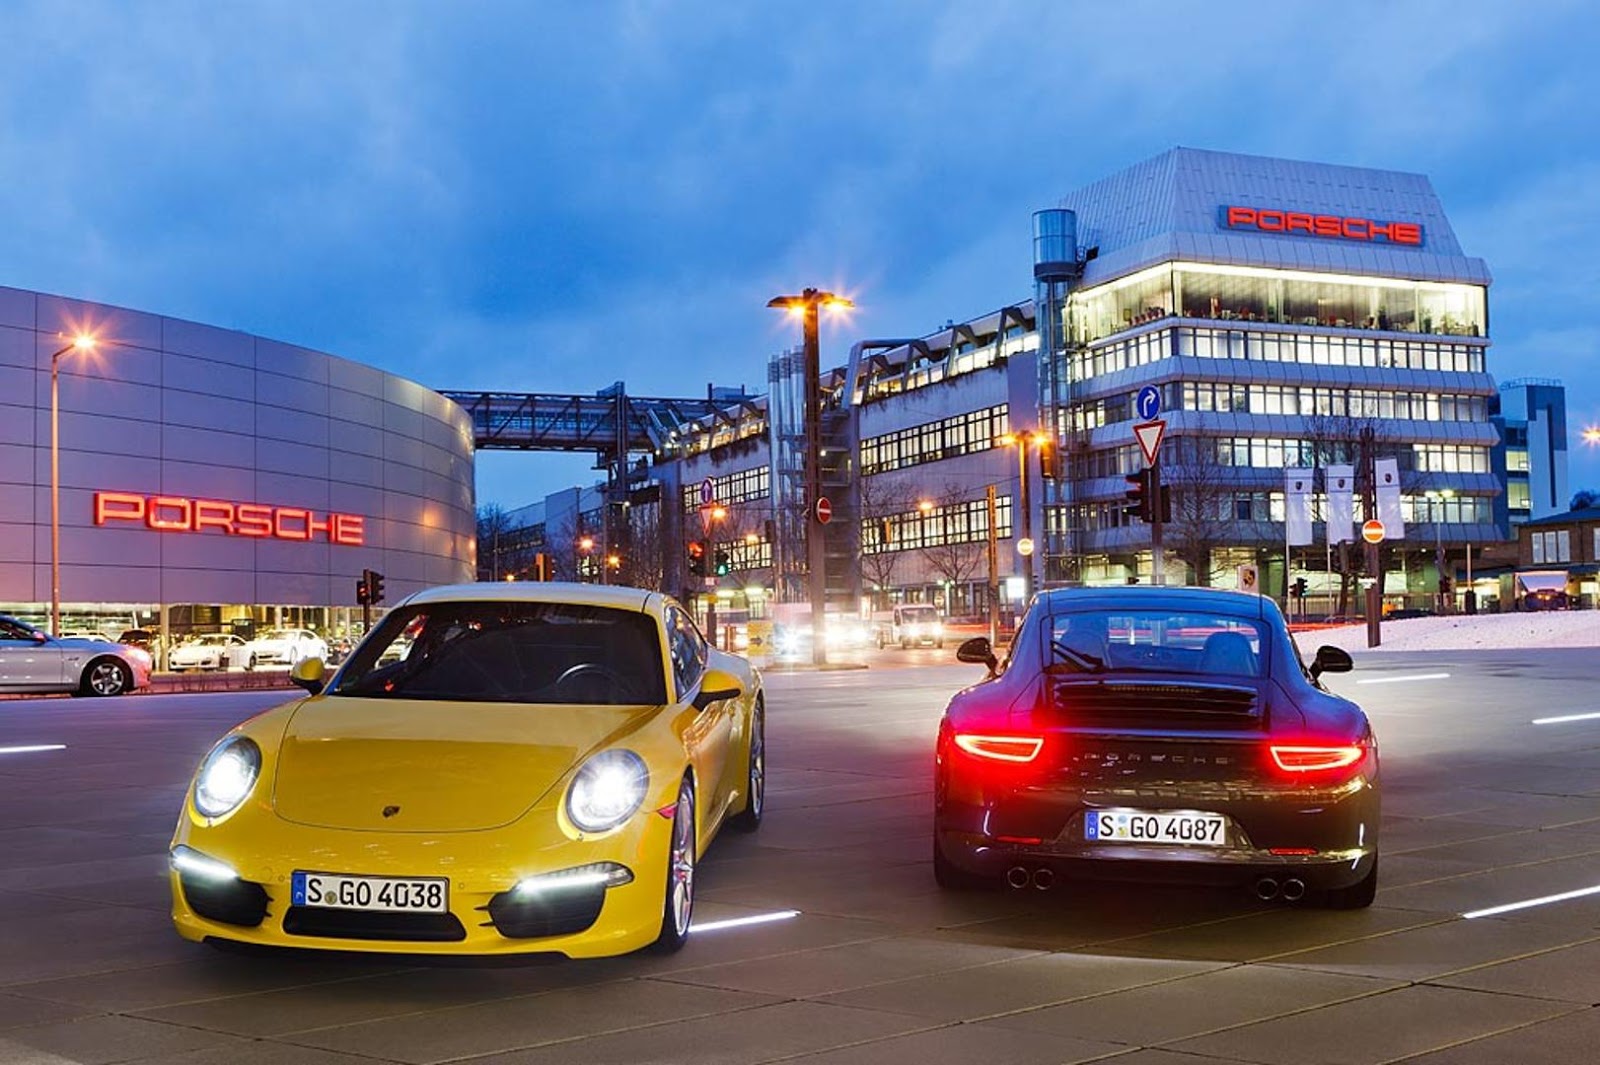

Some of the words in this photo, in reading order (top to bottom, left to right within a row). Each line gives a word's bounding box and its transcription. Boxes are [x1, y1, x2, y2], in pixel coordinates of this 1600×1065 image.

[1228, 206, 1422, 244] PORSCHE
[94, 491, 364, 545] PORSCHE
[1100, 815, 1114, 837] S
[1130, 817, 1159, 839] GO
[1165, 818, 1221, 841] 4087
[308, 878, 322, 903] S
[339, 881, 371, 906] GO
[378, 882, 442, 908] 4038
